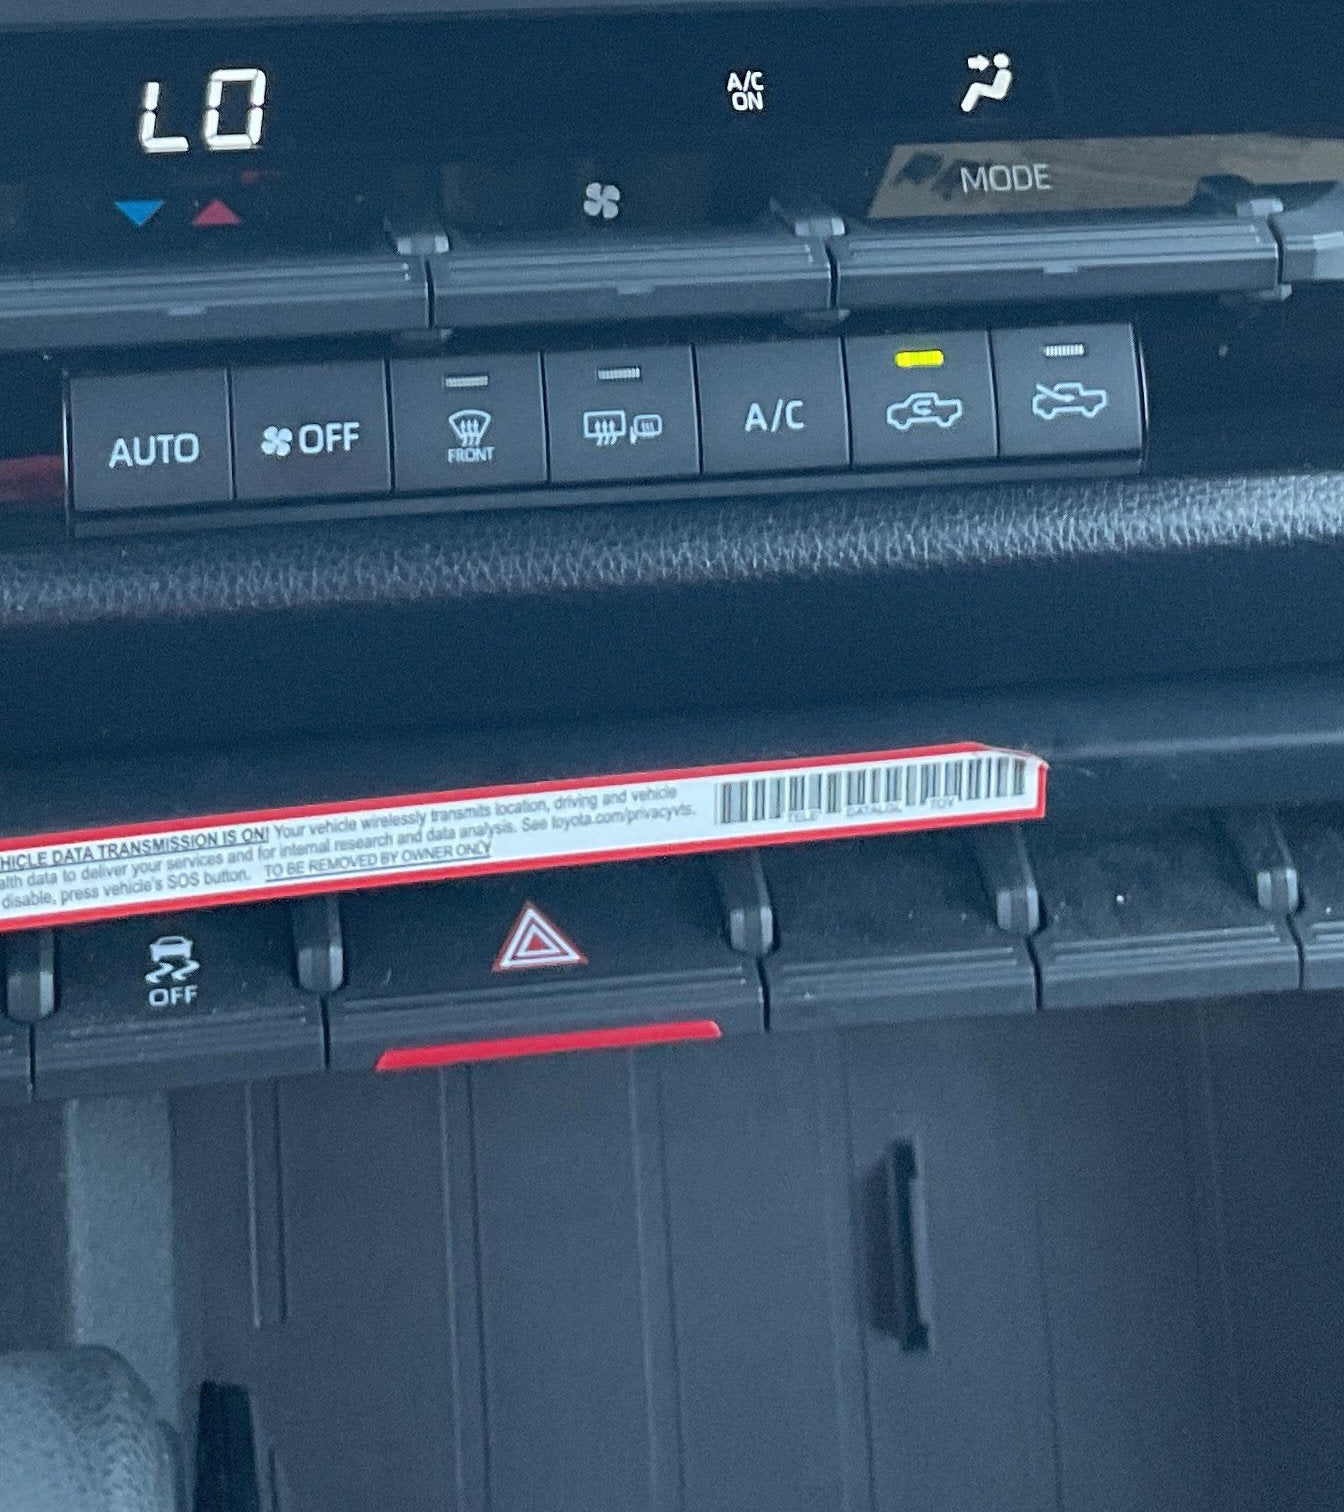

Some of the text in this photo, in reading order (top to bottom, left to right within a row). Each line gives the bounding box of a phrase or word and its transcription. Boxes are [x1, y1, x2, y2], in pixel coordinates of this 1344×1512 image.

[727, 71, 765, 94] A/C
[139, 67, 267, 154] LO
[730, 90, 764, 112] ON
[959, 163, 1053, 194] MODE
[744, 398, 805, 433] A/C
[108, 432, 200, 469] AUTO
[298, 421, 360, 455] OFF
[447, 445, 495, 464] FRONT
[52, 846, 95, 866] DATA
[98, 831, 218, 861] TRANSMISSION
[223, 829, 239, 846] IS
[242, 826, 269, 844] ON!
[274, 823, 305, 840] Your
[309, 816, 357, 836] vehicle
[361, 808, 427, 829] wirelessly
[431, 802, 491, 823] transmits
[494, 797, 551, 817] location,
[554, 791, 599, 811] driving
[602, 788, 627, 806] and
[631, 784, 677, 803] vehicle
[26, 870, 57, 888] data
[62, 867, 77, 883] to
[81, 863, 128, 882] deliver
[132, 859, 163, 879] your
[166, 851, 224, 872] services
[228, 847, 253, 865] and
[257, 844, 275, 861] for
[279, 838, 331, 858] internal
[334, 832, 394, 852] research
[398, 828, 423, 846] and
[427, 825, 456, 842] data
[459, 818, 517, 840] analysis.
[522, 815, 548, 833] See
[2, 889, 57, 910] disable,
[61, 886, 99, 905] press
[103, 876, 163, 897] vehicle's
[167, 869, 200, 889] SOS
[204, 867, 252, 886] button.
[264, 862, 284, 878] TO
[287, 859, 305, 875] BE
[308, 852, 378, 872] REMOVED
[381, 849, 400, 865] BY
[401, 844, 454, 863] OWNER
[456, 839, 491, 857] ONLY
[148, 985, 198, 1007] OFF
